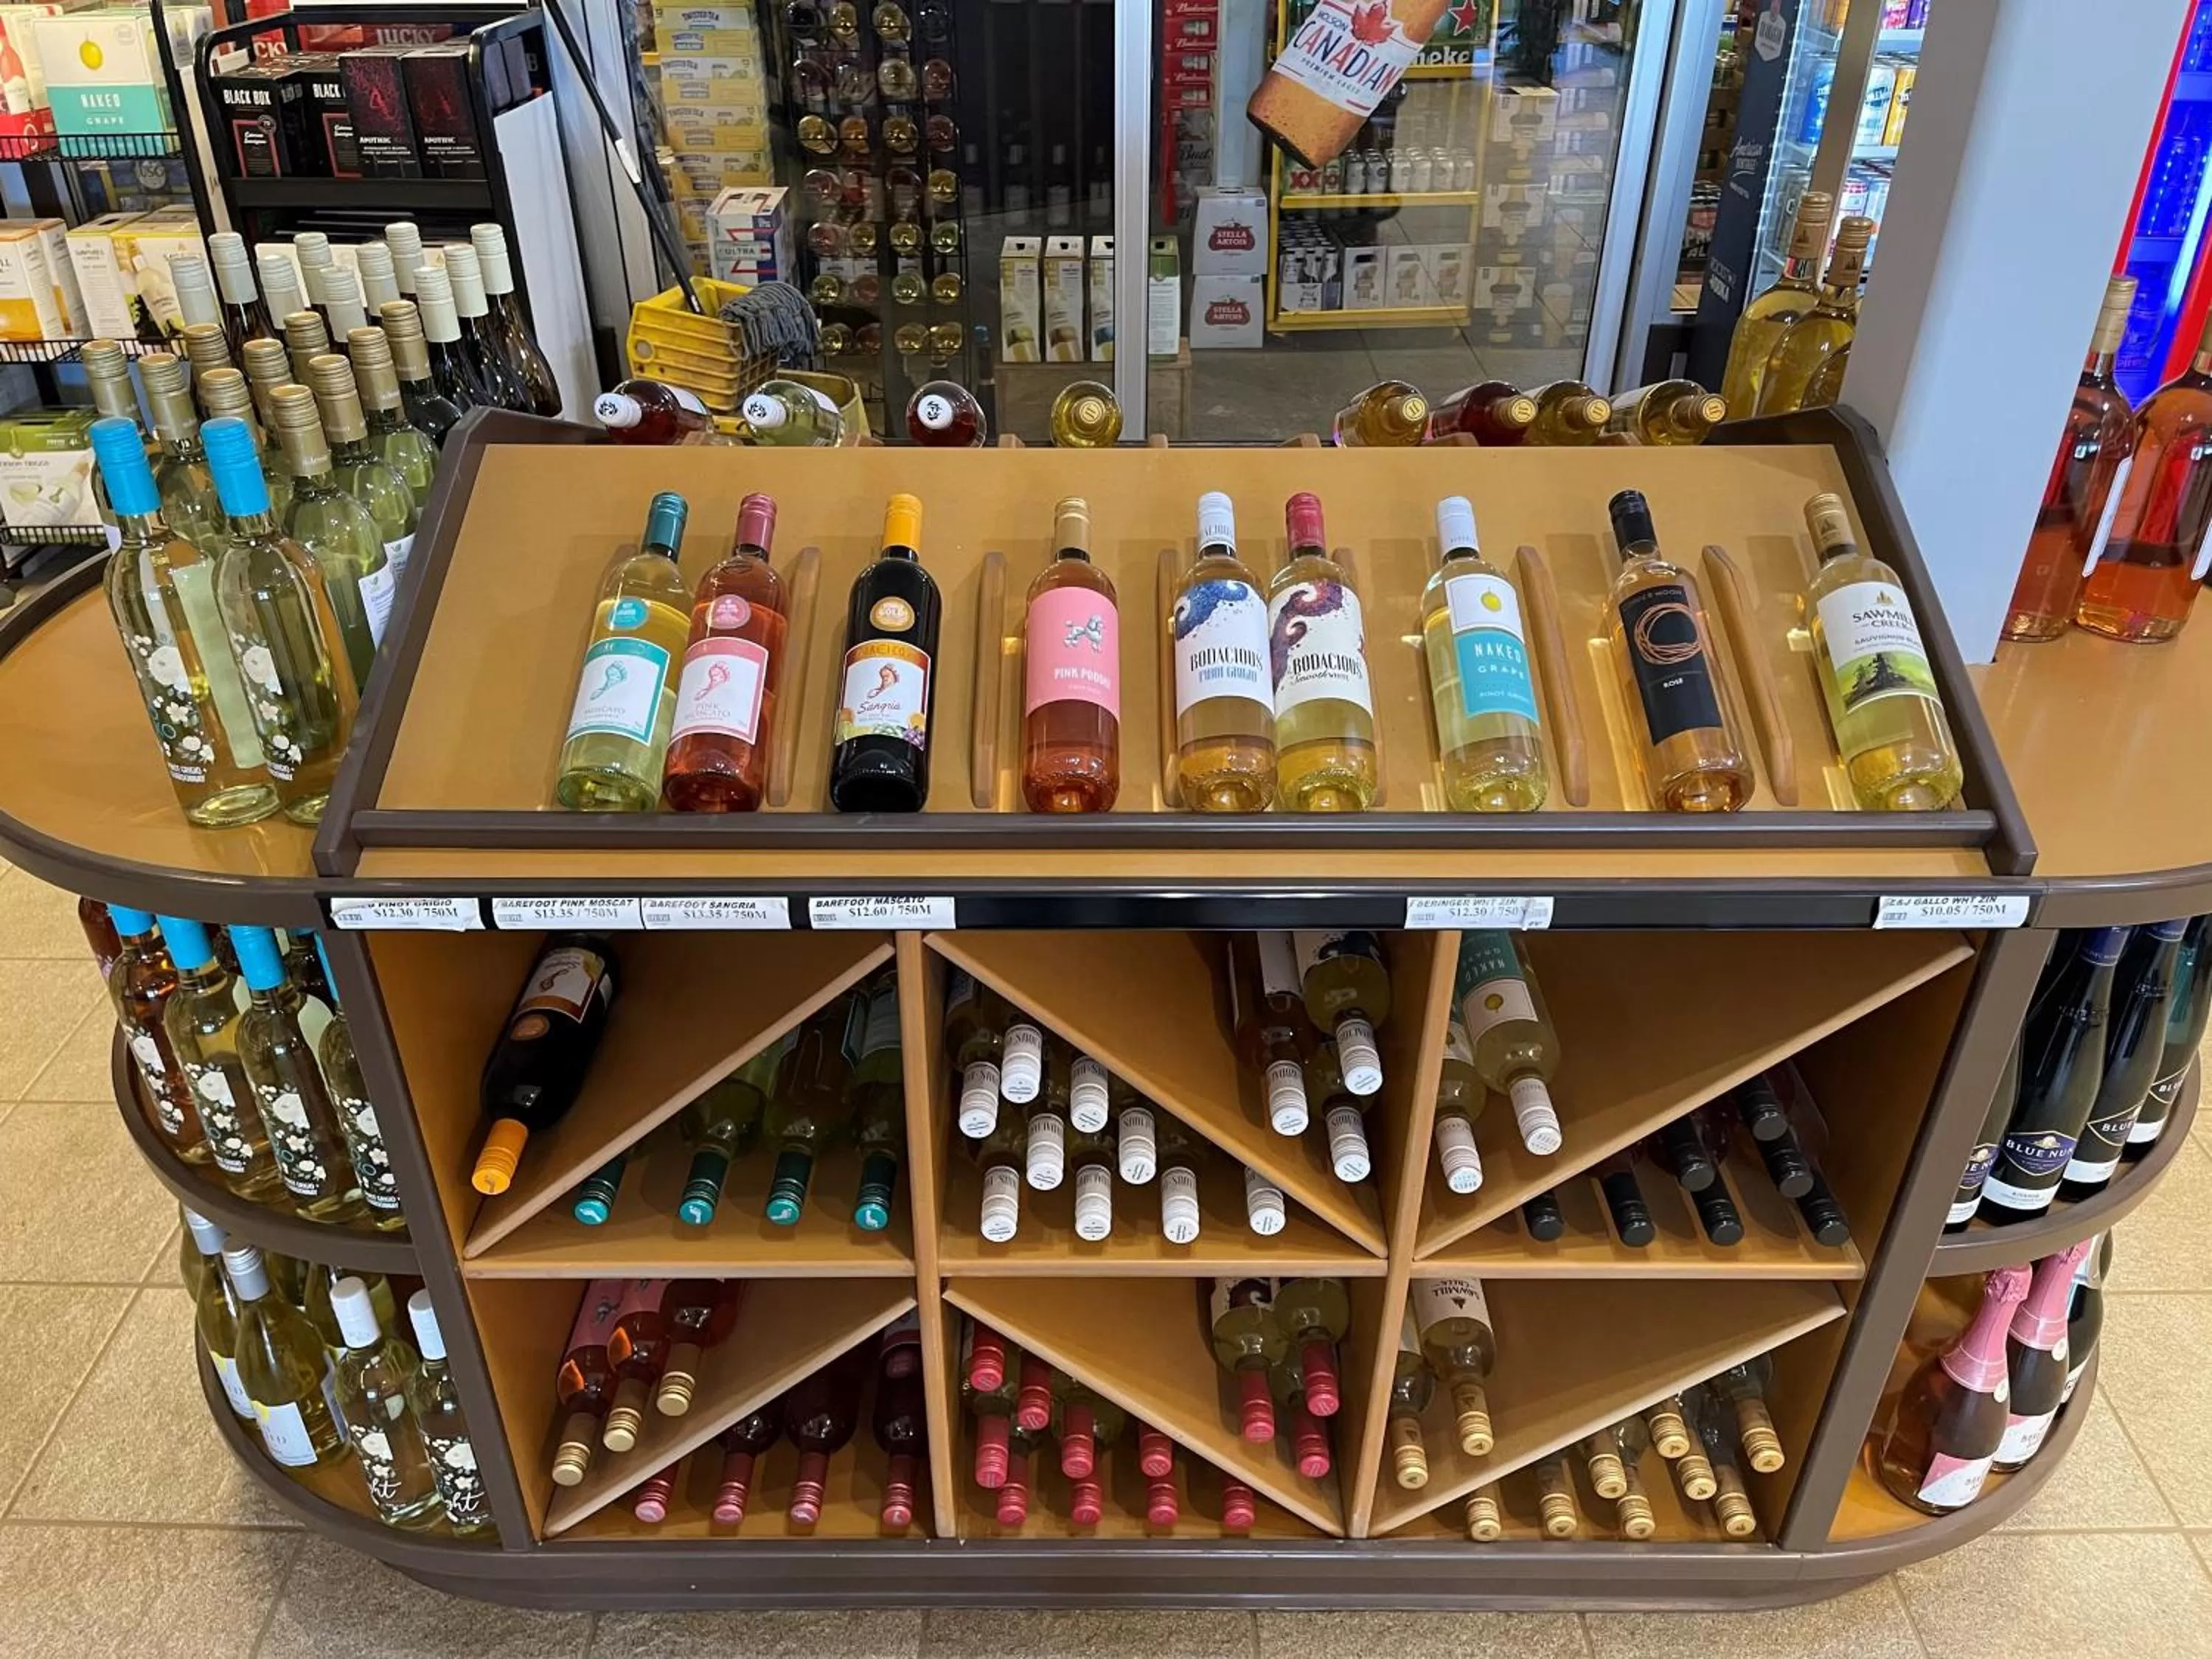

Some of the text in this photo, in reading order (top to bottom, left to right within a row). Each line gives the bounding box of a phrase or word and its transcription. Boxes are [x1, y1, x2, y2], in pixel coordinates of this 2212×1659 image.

[1317, 10, 1349, 32] MOLSON
[376, 28, 437, 45] LUCKY
[1293, 21, 1401, 95] CANADIAN
[1411, 45, 1470, 66] neke
[1300, 58, 1335, 80] PREMIUM
[223, 88, 252, 104] BLACK
[253, 90, 272, 105] BOX
[313, 83, 341, 98] BLACK
[80, 93, 122, 108] NAKED
[86, 116, 125, 126] GRAPE
[1217, 230, 1247, 238] STELLA
[1852, 610, 1915, 627] SAWMILL
[1190, 646, 1264, 672] BODACIOUS
[1475, 642, 1522, 664] NAKED
[1054, 667, 1079, 680] PINK
[1292, 653, 1363, 680] BODACIOUS
[857, 700, 902, 715] Sangria
[501, 899, 634, 908] BAREFOOT PINK MOSCAT
[650, 900, 757, 909] BAREFOOT SANGRIA
[815, 897, 872, 908] BAREFOOT
[1913, 897, 1950, 905] GALLO
[374, 908, 414, 918] $12.30
[424, 908, 459, 918] 750M
[534, 908, 573, 919] $13.35
[684, 910, 723, 919] $13.35
[732, 910, 767, 919] 750M
[849, 907, 888, 917] $12.60
[898, 905, 931, 915] 750M
[1921, 905, 1961, 917] $10.05
[1973, 904, 2006, 914] 750M
[2101, 1120, 2135, 1133] BLUE
[2006, 1139, 2074, 1158] BLUE NUN
